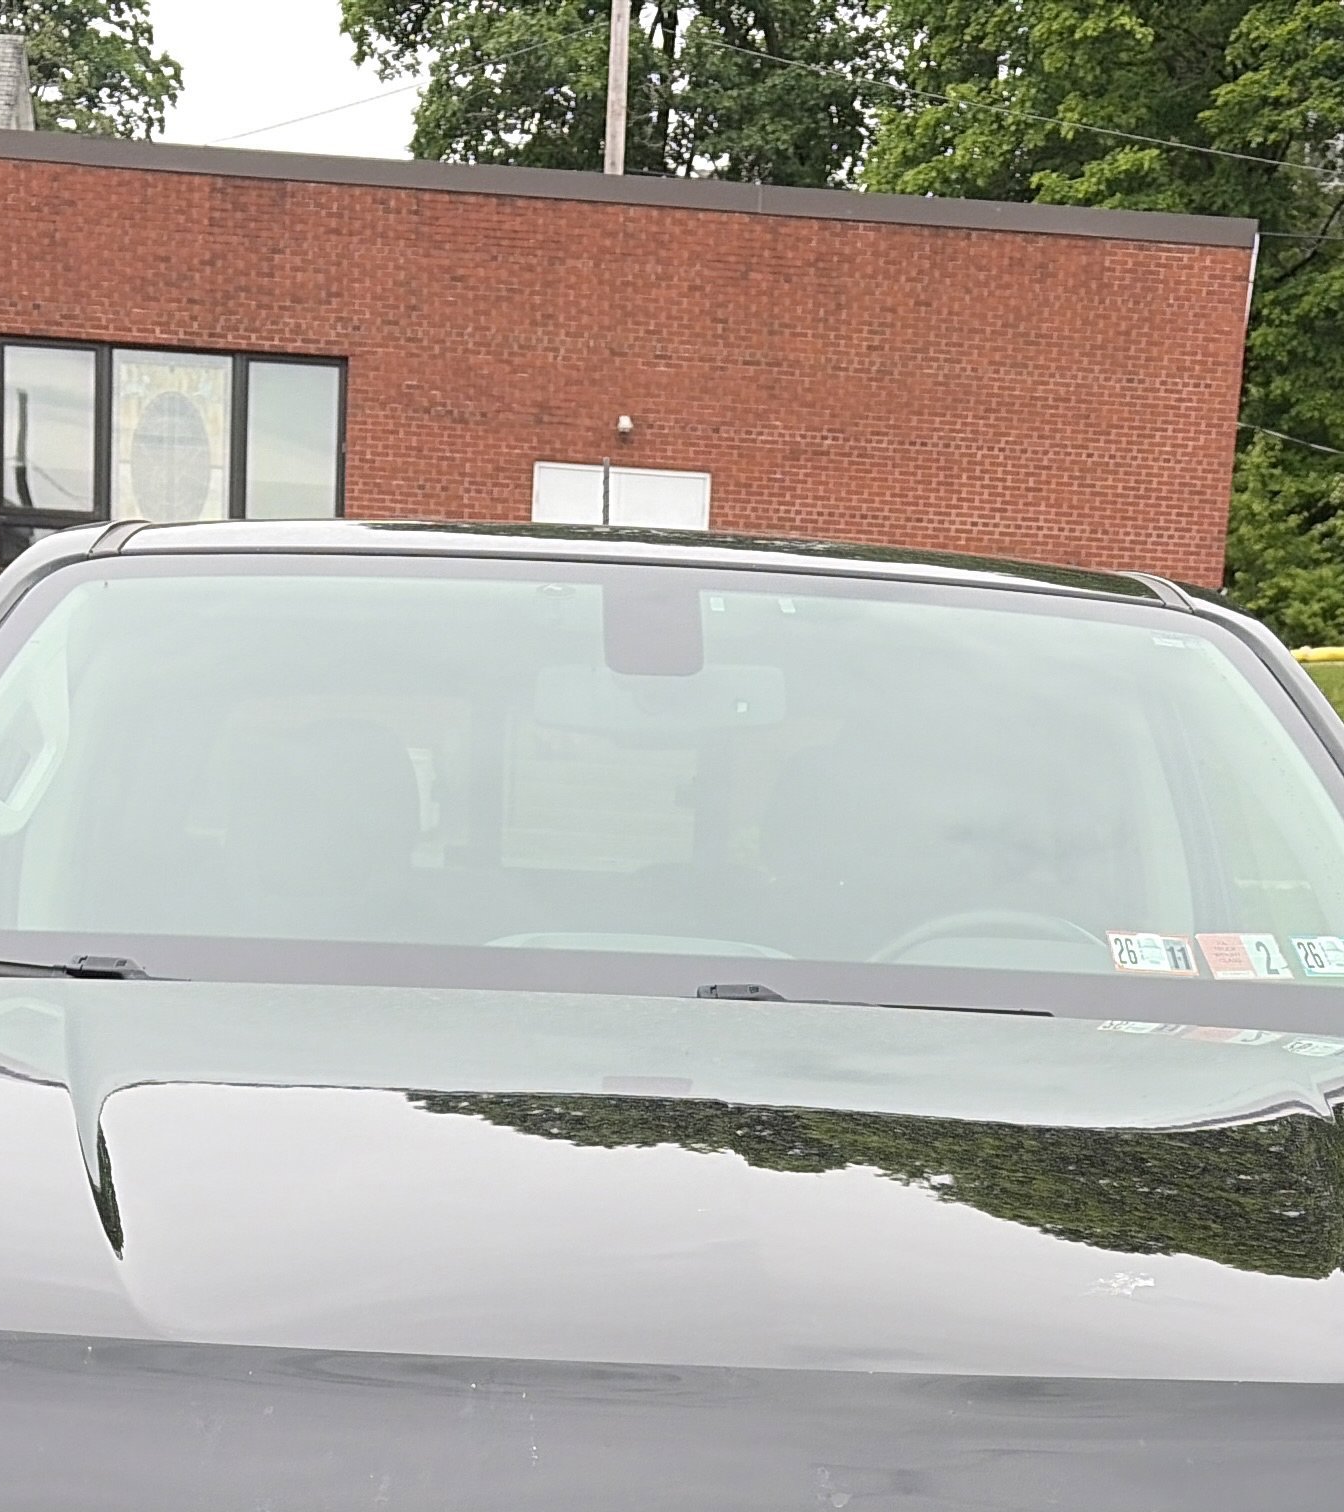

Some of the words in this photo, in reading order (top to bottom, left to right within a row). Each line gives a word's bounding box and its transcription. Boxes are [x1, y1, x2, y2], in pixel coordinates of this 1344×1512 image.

[1114, 938, 1138, 965] 26
[1166, 946, 1191, 970] 11
[1256, 941, 1280, 975] 2
[1297, 942, 1325, 969] 26
